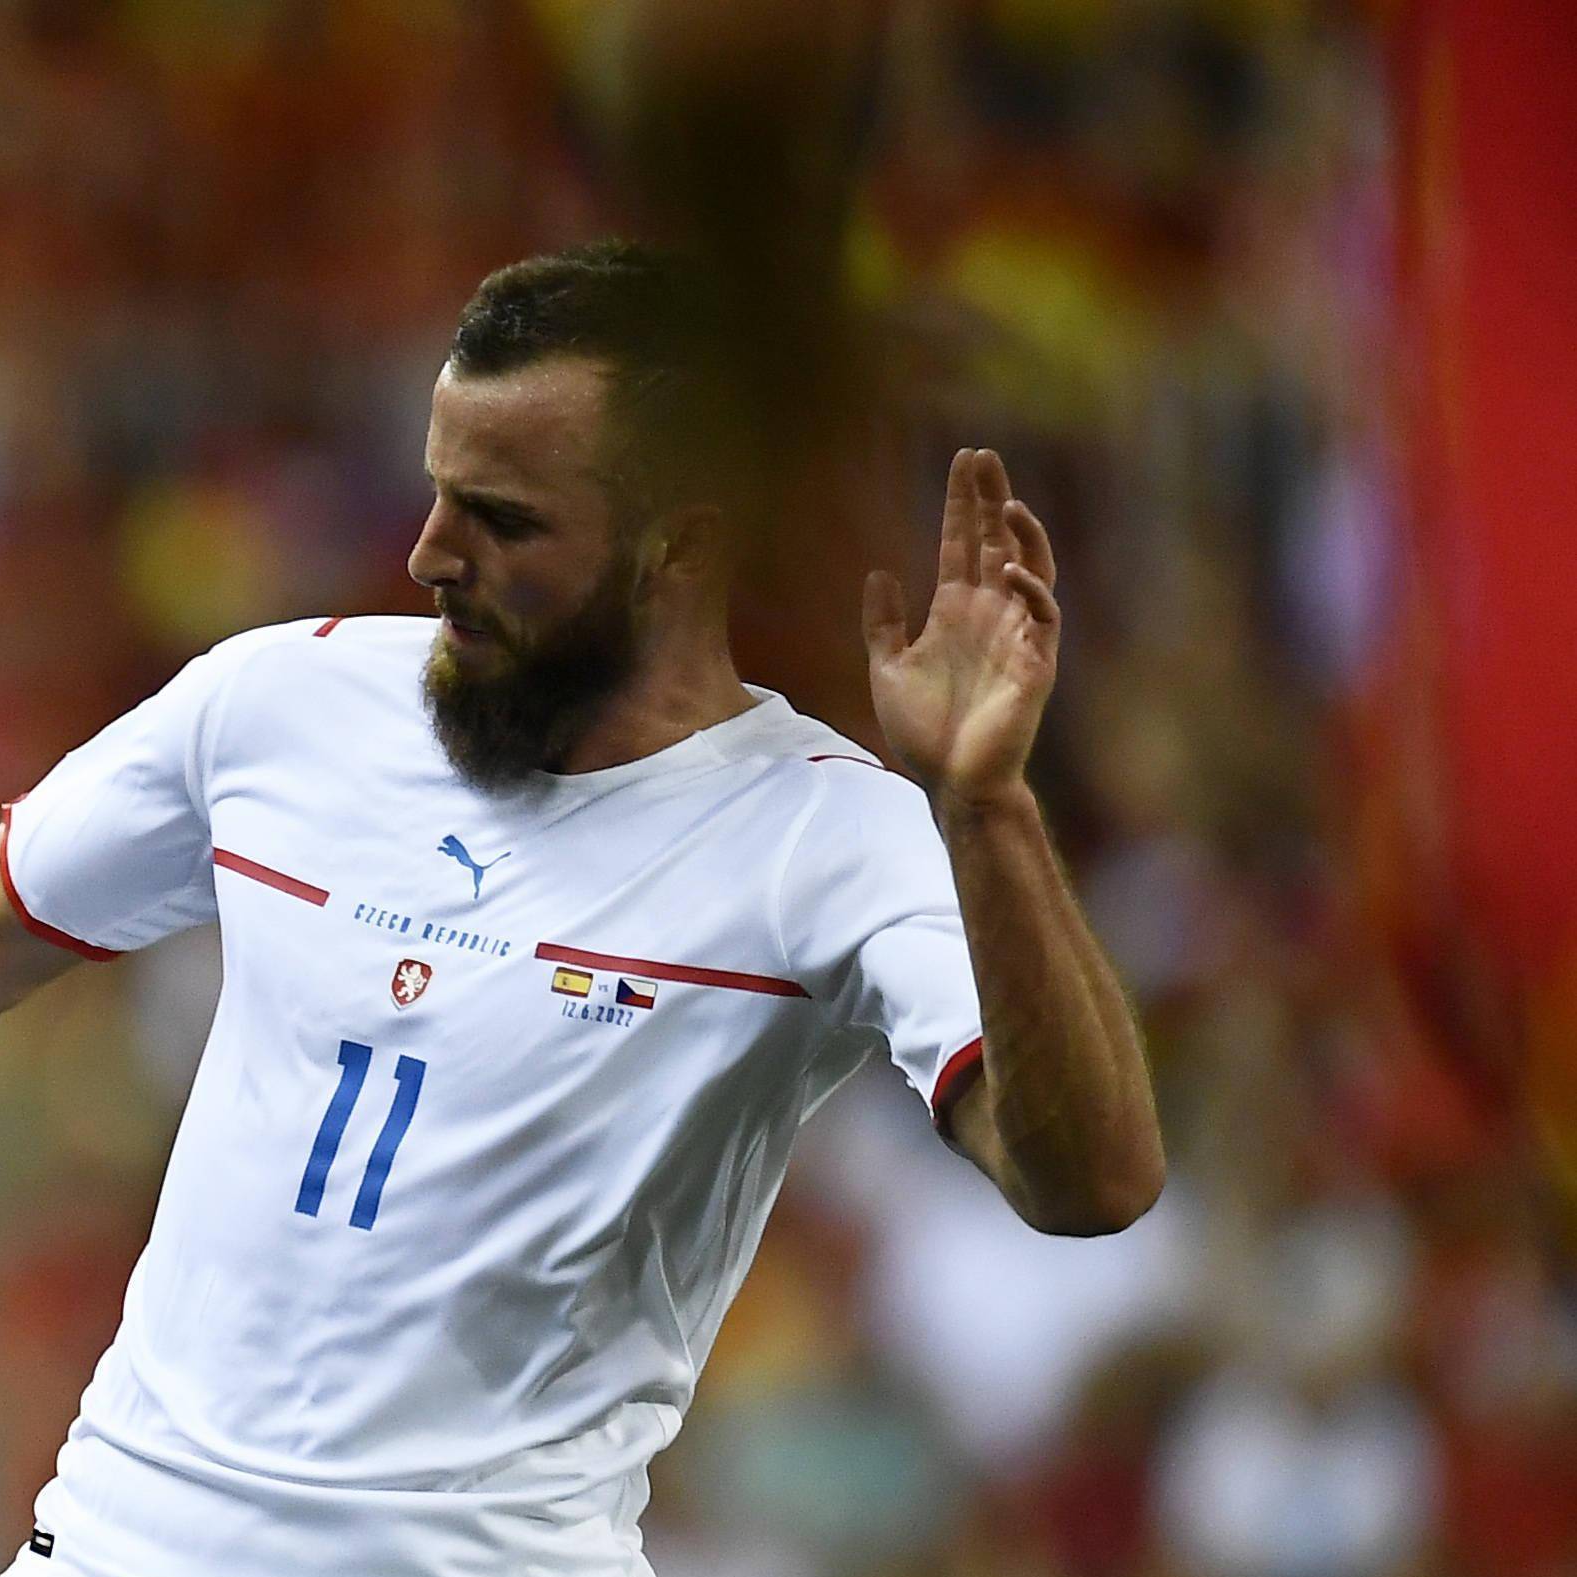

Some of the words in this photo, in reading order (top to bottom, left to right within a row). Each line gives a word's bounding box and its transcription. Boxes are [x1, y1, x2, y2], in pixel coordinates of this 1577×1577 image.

[354, 903, 411, 933] CZECH
[422, 923, 511, 957] REPUBLIC
[562, 1000, 634, 1028] 12.6.2022
[294, 1039, 428, 1231] 11
